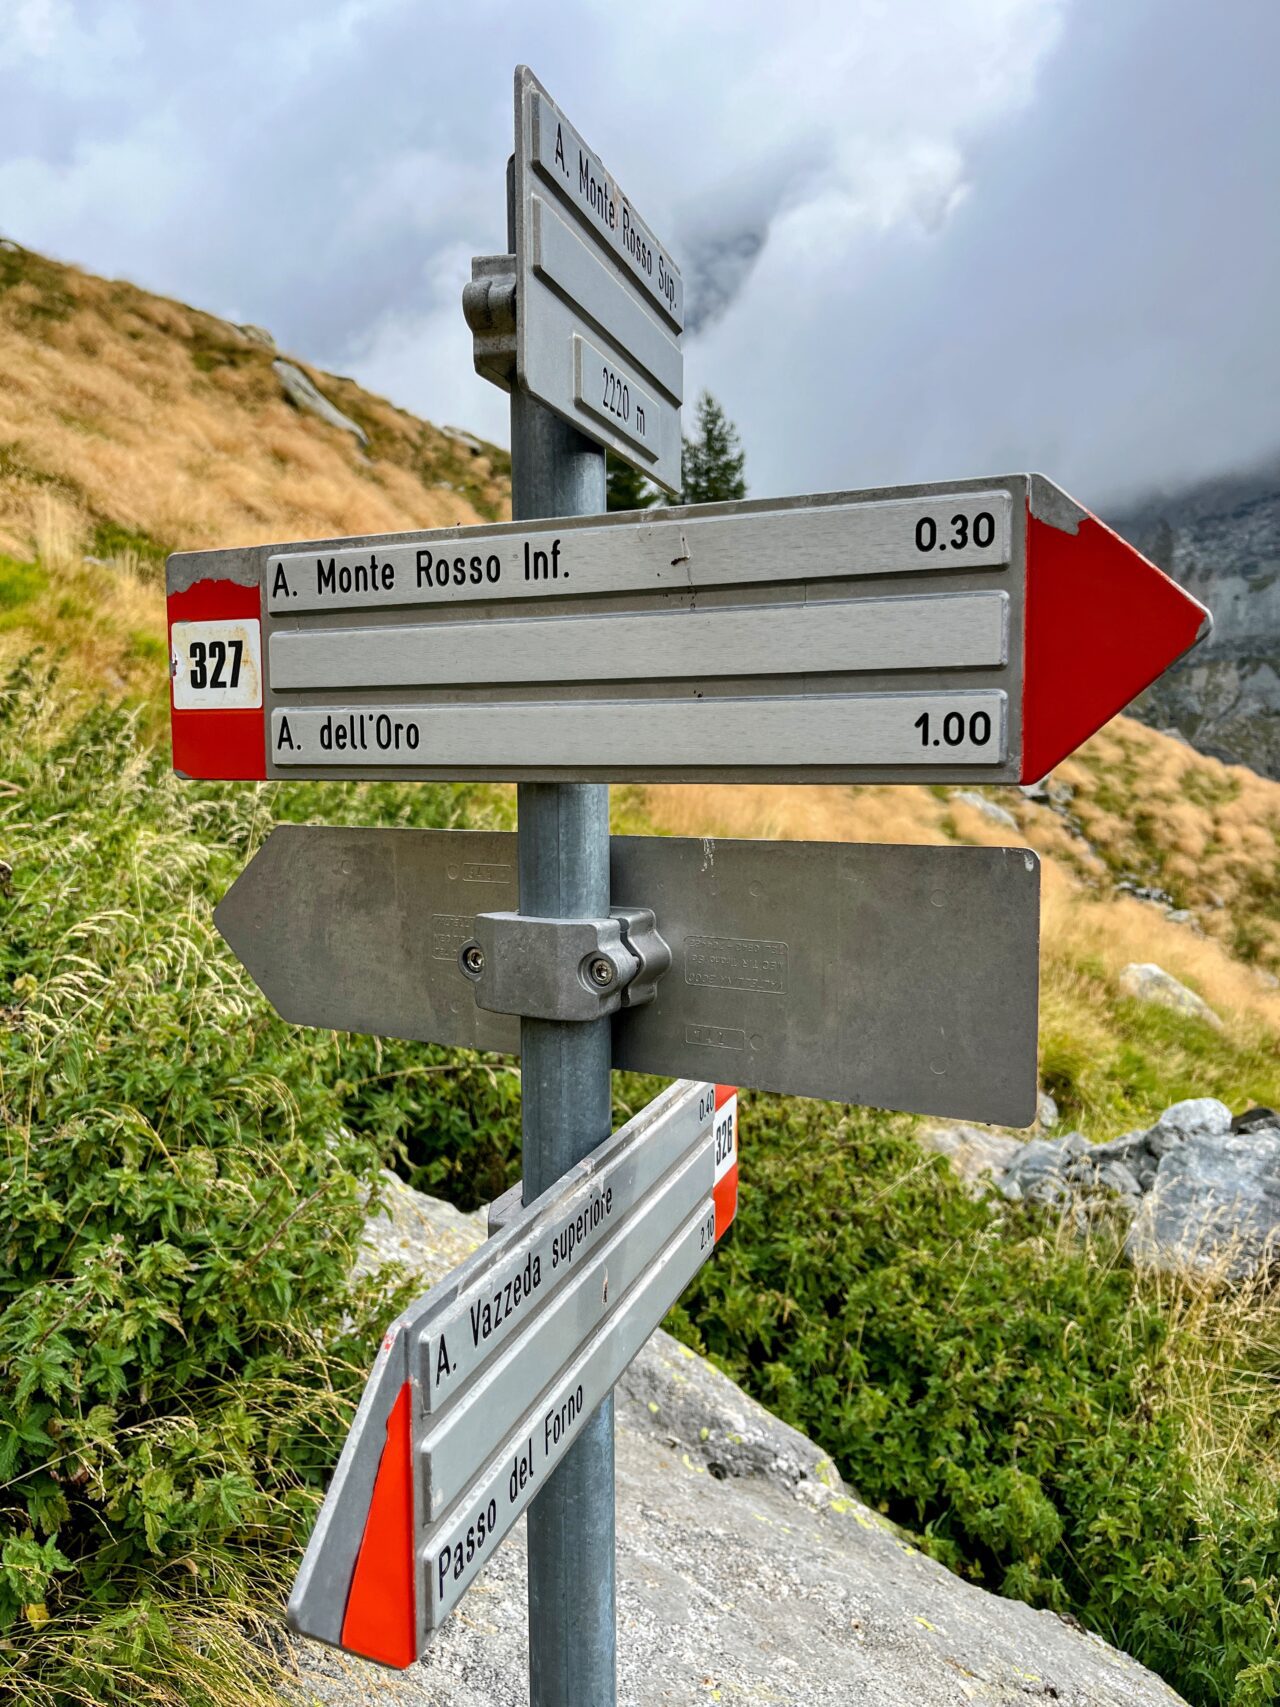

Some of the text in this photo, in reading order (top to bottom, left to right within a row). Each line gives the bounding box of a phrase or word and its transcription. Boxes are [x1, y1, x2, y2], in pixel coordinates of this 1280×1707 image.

[555, 122, 677, 311] A. Monte Rosso Sup.
[602, 367, 646, 436] 2220 m
[915, 512, 995, 552] 0.30
[273, 539, 571, 598] A. Monte Rosso Inf.
[189, 640, 243, 689] 327
[277, 713, 420, 750] A. dell'Oro
[914, 711, 991, 747] 1.00
[699, 1089, 714, 1122] 0.40
[715, 1114, 733, 1166] 326
[436, 1187, 613, 1386] A. Vazzeda superiore
[438, 1384, 583, 1600] Passo del Forno
